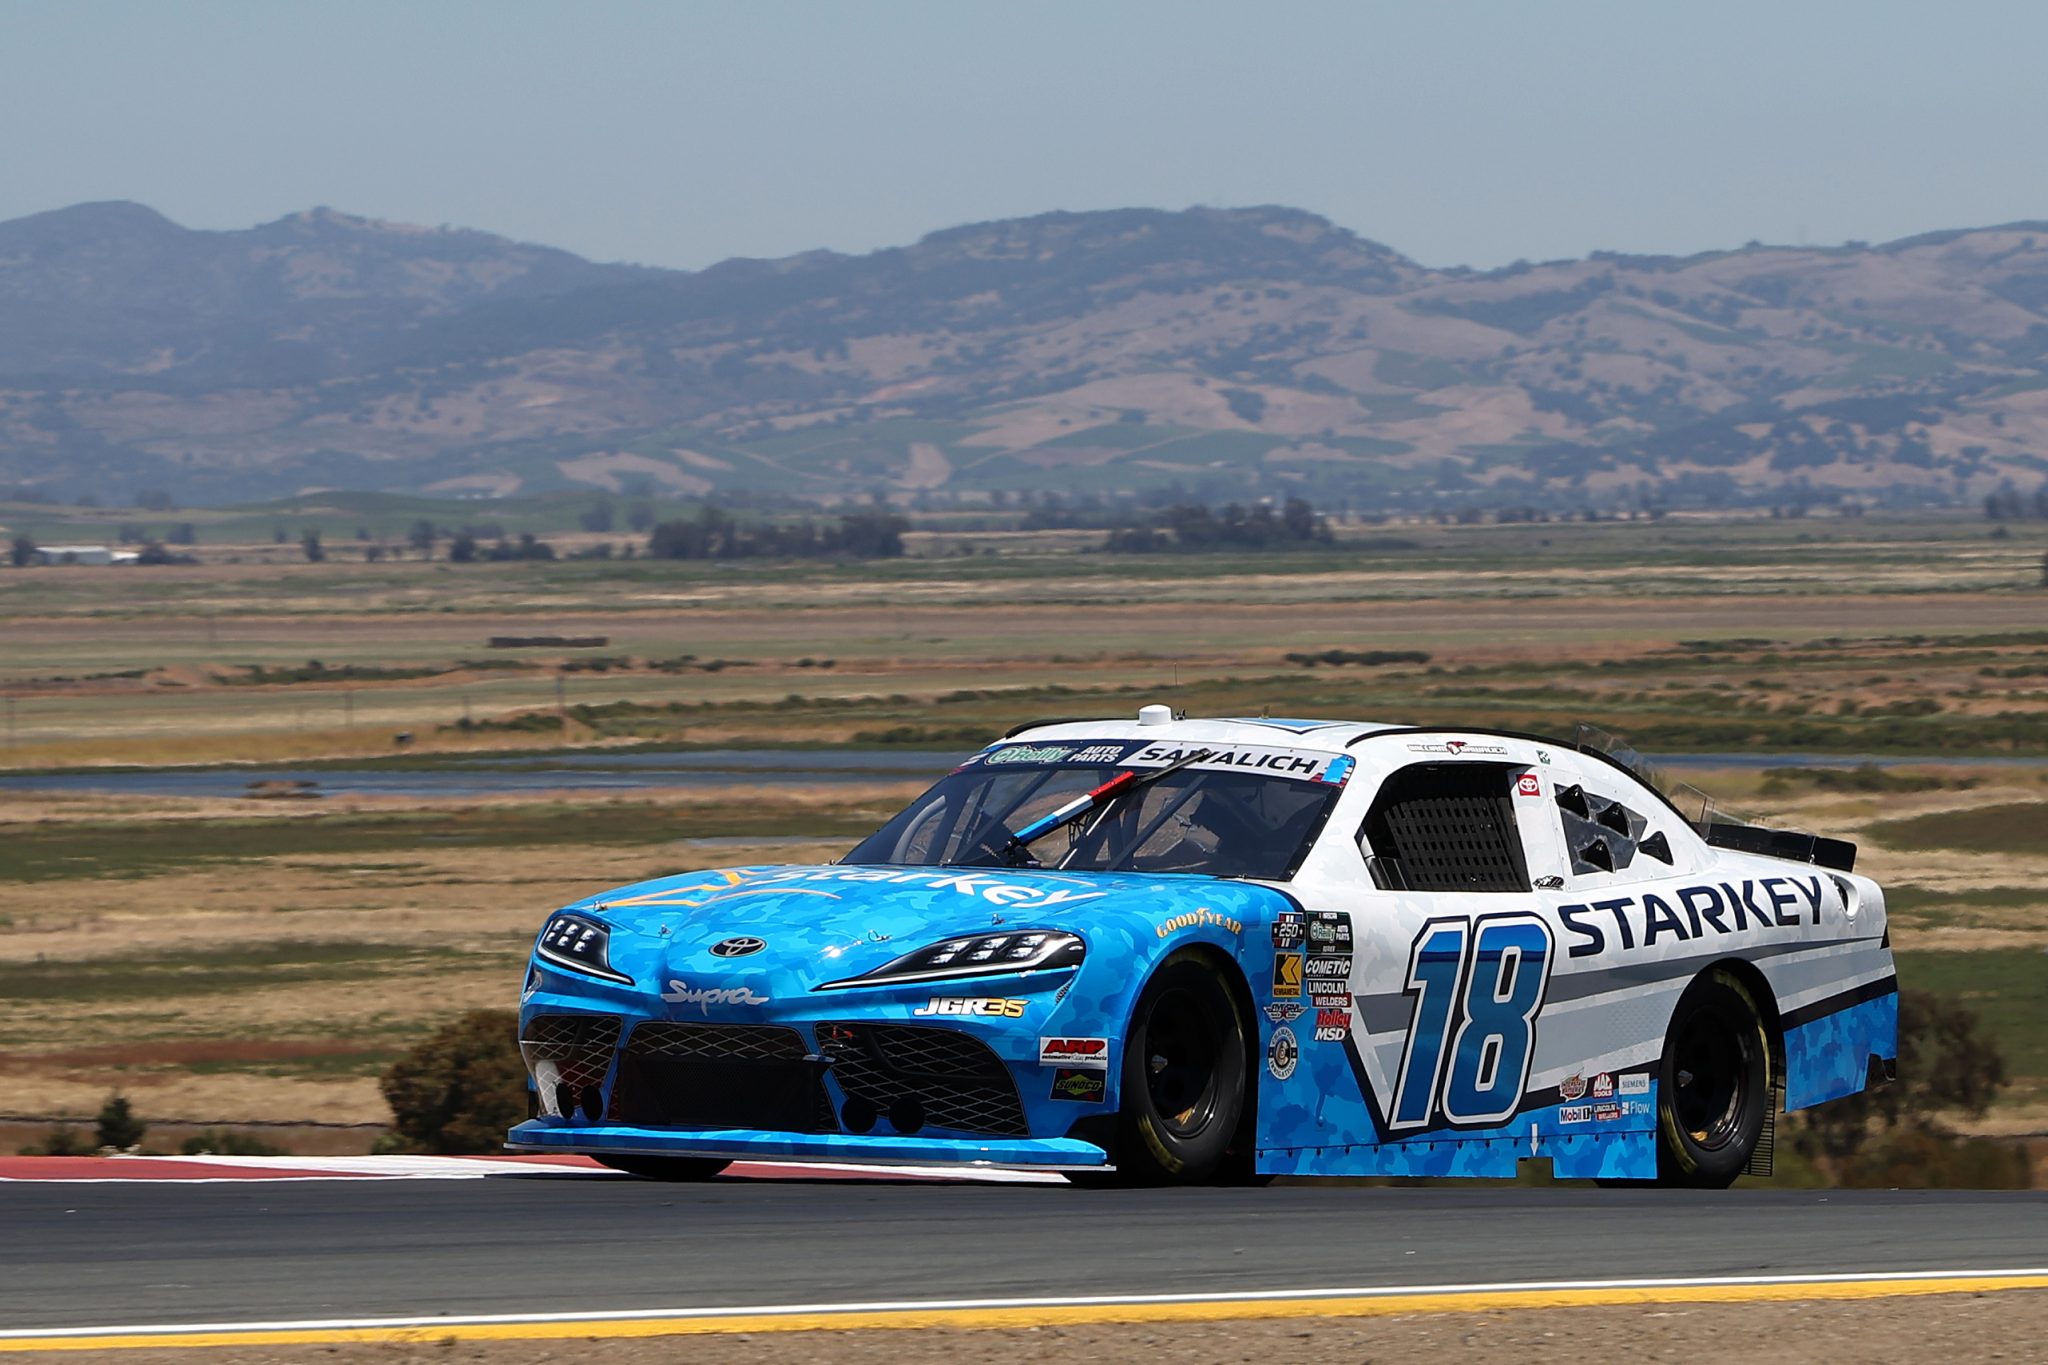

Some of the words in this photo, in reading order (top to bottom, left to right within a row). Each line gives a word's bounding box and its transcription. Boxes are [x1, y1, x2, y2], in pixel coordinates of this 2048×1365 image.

[1080, 745, 1124, 754] AUTO
[1067, 753, 1119, 762] PARTS
[1156, 907, 1243, 938] GOODYEAR
[1557, 875, 1822, 958] STARKEY
[1279, 923, 1299, 937] 250
[1305, 960, 1351, 974] COMETIC
[1308, 981, 1344, 994] LINCOLN
[660, 980, 769, 1016] Supra
[1315, 996, 1348, 1006] WELDERS
[913, 996, 1030, 1018] JGR35
[1389, 914, 1554, 1131] 18
[1314, 1027, 1346, 1041] MSD
[1042, 1039, 1106, 1054] ARP
[1057, 1080, 1102, 1091] SUNOCO
[1622, 1079, 1646, 1088] SIEMENS
[1594, 1089, 1613, 1097] TOOLS
[1560, 1108, 1582, 1122] Mobil
[1583, 1107, 1590, 1120] 1
[1630, 1101, 1650, 1114] Flow
